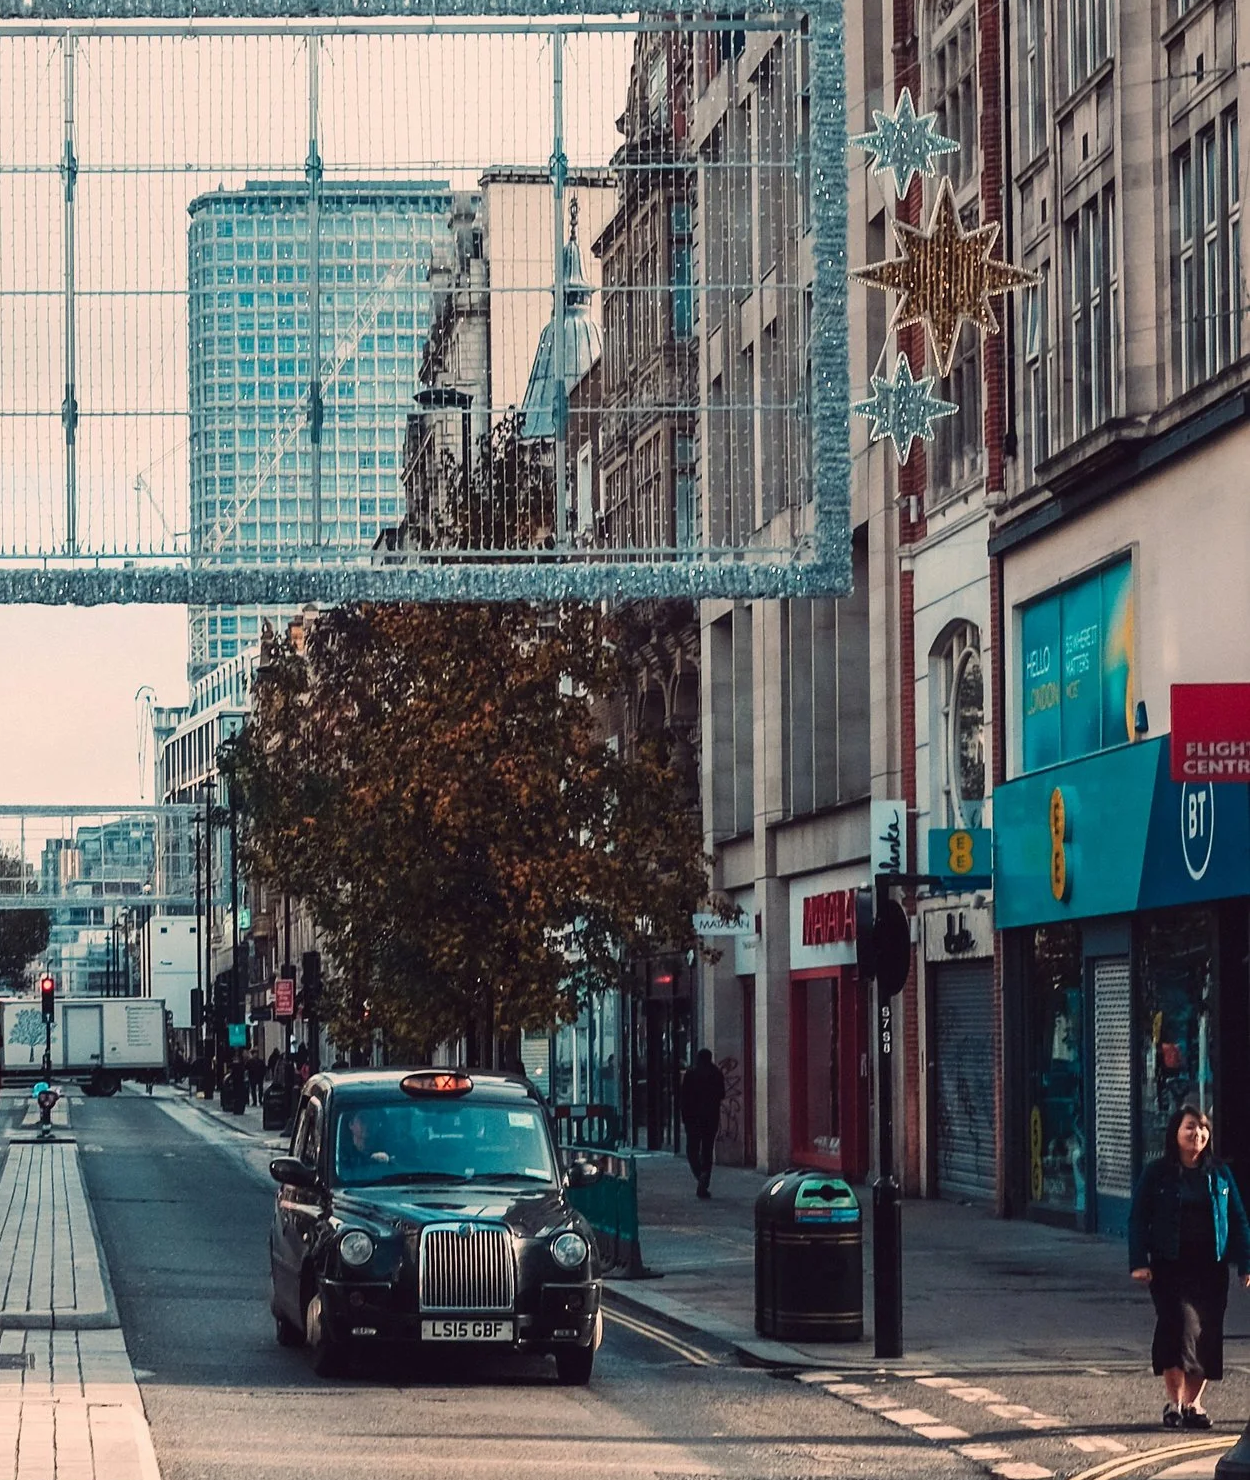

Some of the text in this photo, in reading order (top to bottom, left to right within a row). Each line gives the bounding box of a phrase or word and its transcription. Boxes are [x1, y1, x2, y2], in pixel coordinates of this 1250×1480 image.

[1027, 646, 1050, 679] HELLO
[1188, 790, 1206, 840] BT
[803, 890, 856, 946] MATALA
[432, 1322, 503, 1337] LS15 GBF
